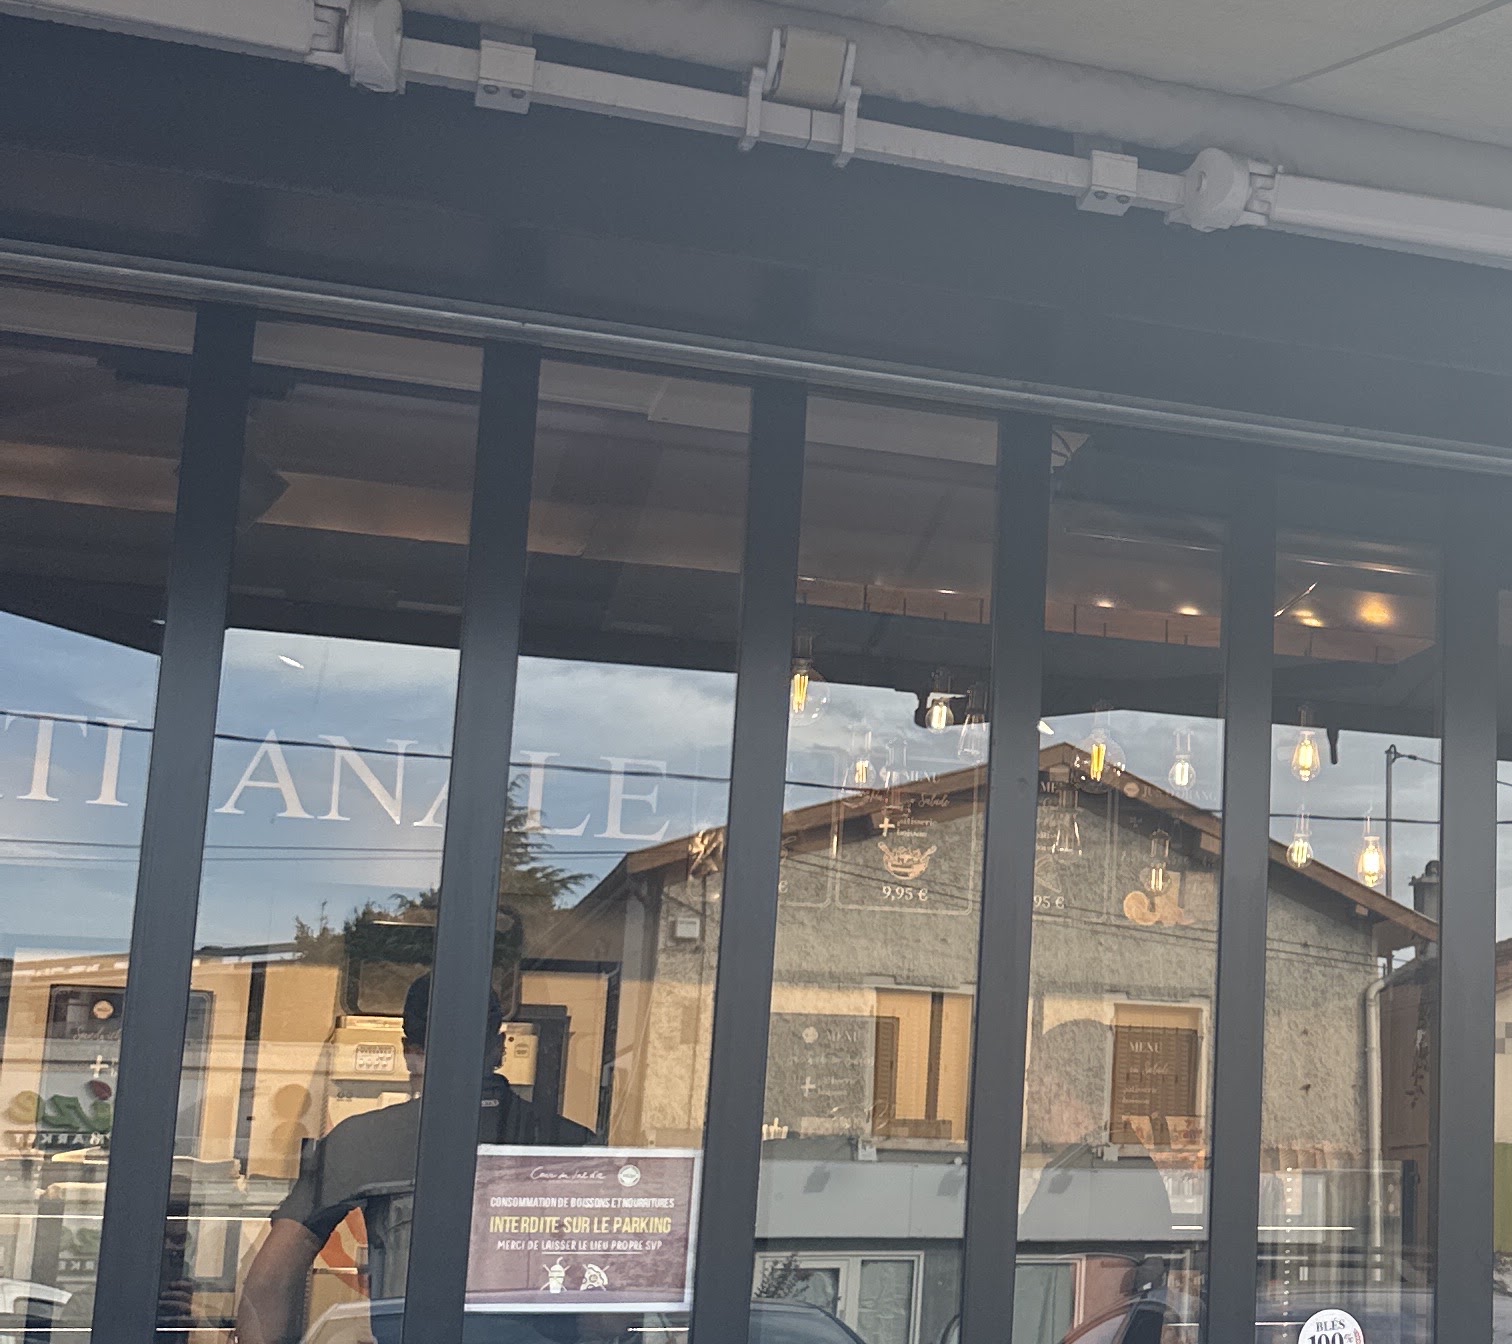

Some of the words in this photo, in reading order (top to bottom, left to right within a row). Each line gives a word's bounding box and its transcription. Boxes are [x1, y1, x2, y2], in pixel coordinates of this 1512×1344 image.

[882, 886, 914, 901] 9,95
[918, 888, 928, 902] €
[489, 1196, 557, 1208] CONSOMMATION
[557, 1197, 569, 1208] DE
[570, 1197, 611, 1208] BOISSONS
[611, 1198, 622, 1208] ET
[622, 1198, 675, 1209] NOURRITURES
[489, 1216, 560, 1233] INTERDITE
[563, 1217, 590, 1234] SUR
[593, 1217, 610, 1233] LE
[613, 1217, 672, 1234] PARKING
[496, 1240, 525, 1251] MERCI
[527, 1240, 539, 1251] DE
[541, 1240, 577, 1251] LAISSER
[578, 1241, 588, 1251] LE
[590, 1240, 609, 1251] LIEU
[611, 1241, 643, 1251] PROPRE
[645, 1241, 662, 1251] SVP
[1316, 1317, 1346, 1332] BLÉS
